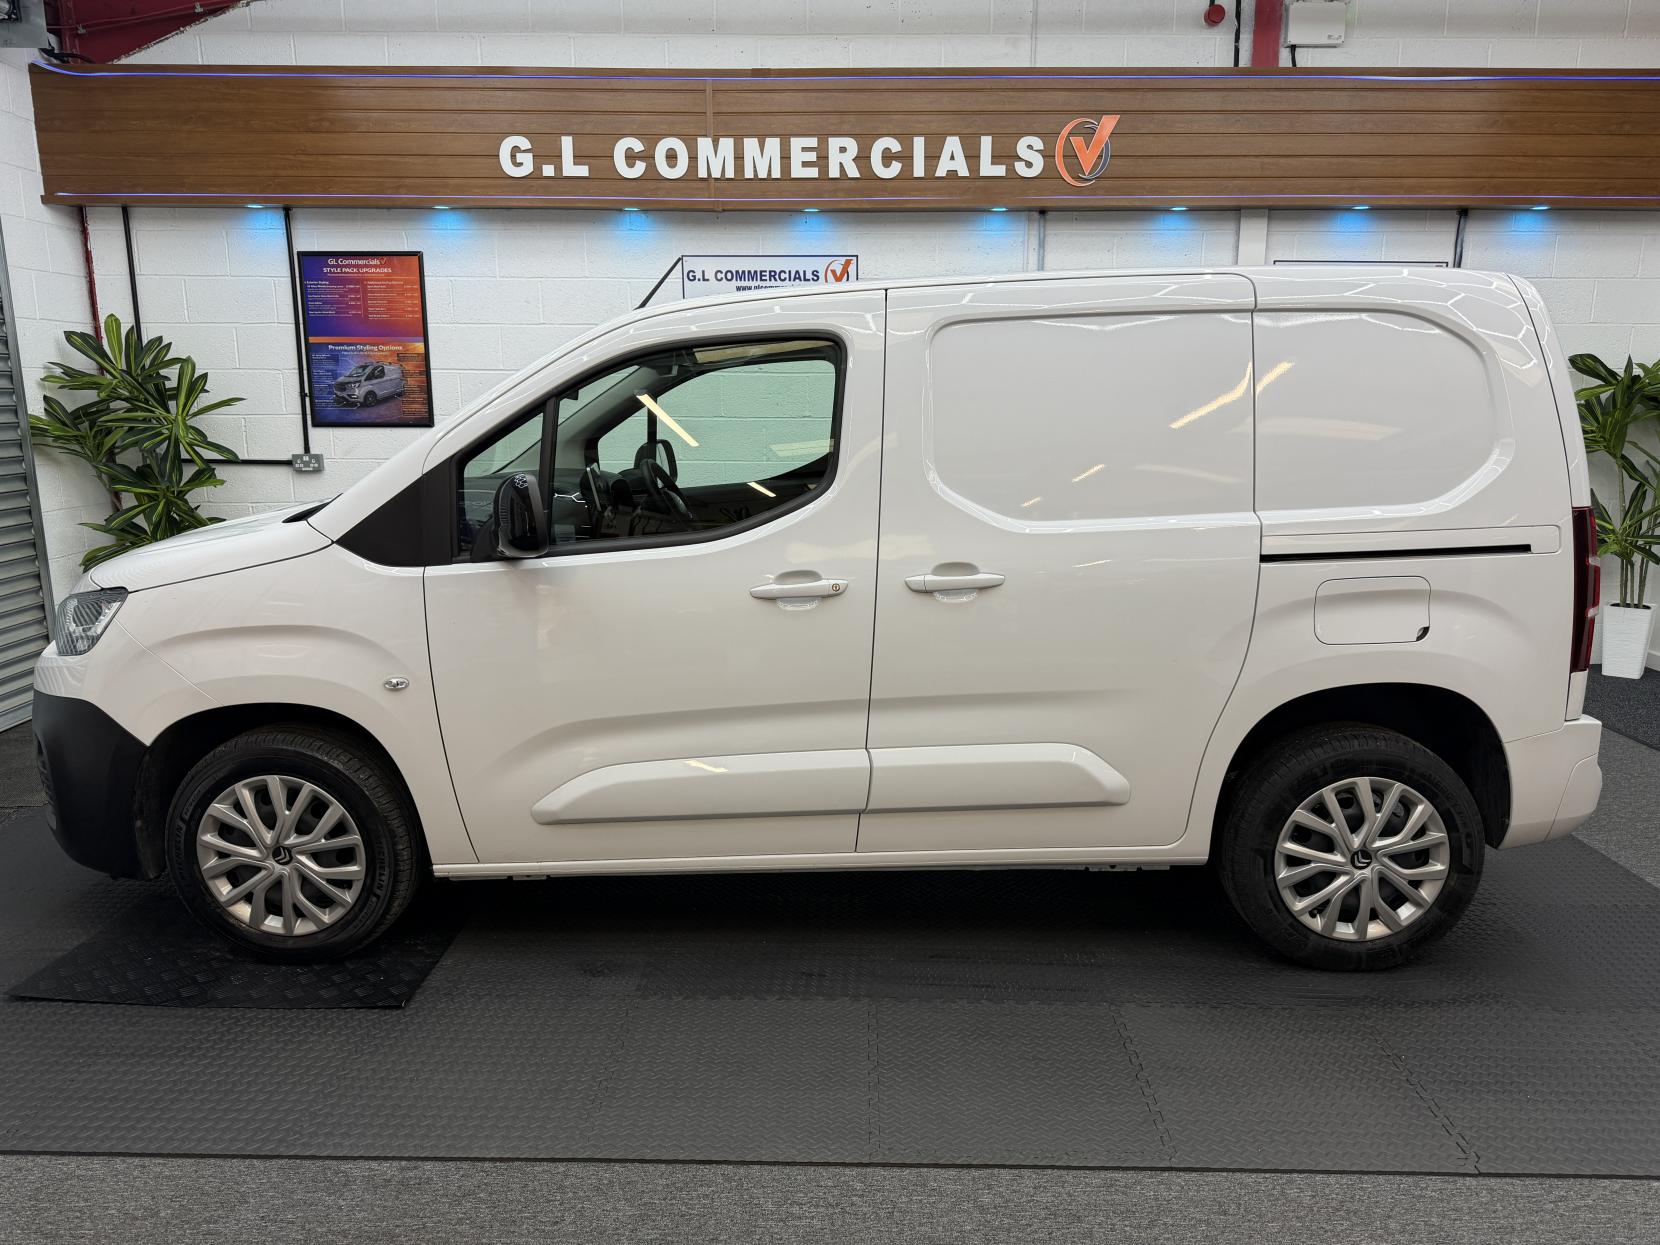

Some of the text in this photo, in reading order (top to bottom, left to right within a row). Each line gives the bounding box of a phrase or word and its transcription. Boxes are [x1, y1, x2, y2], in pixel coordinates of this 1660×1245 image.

[499, 135, 1045, 179] G.L COMMERCIALS
[686, 269, 820, 282] G.L COMMERCIALS
[356, 344, 378, 352] Styling
[378, 344, 403, 352] Options
